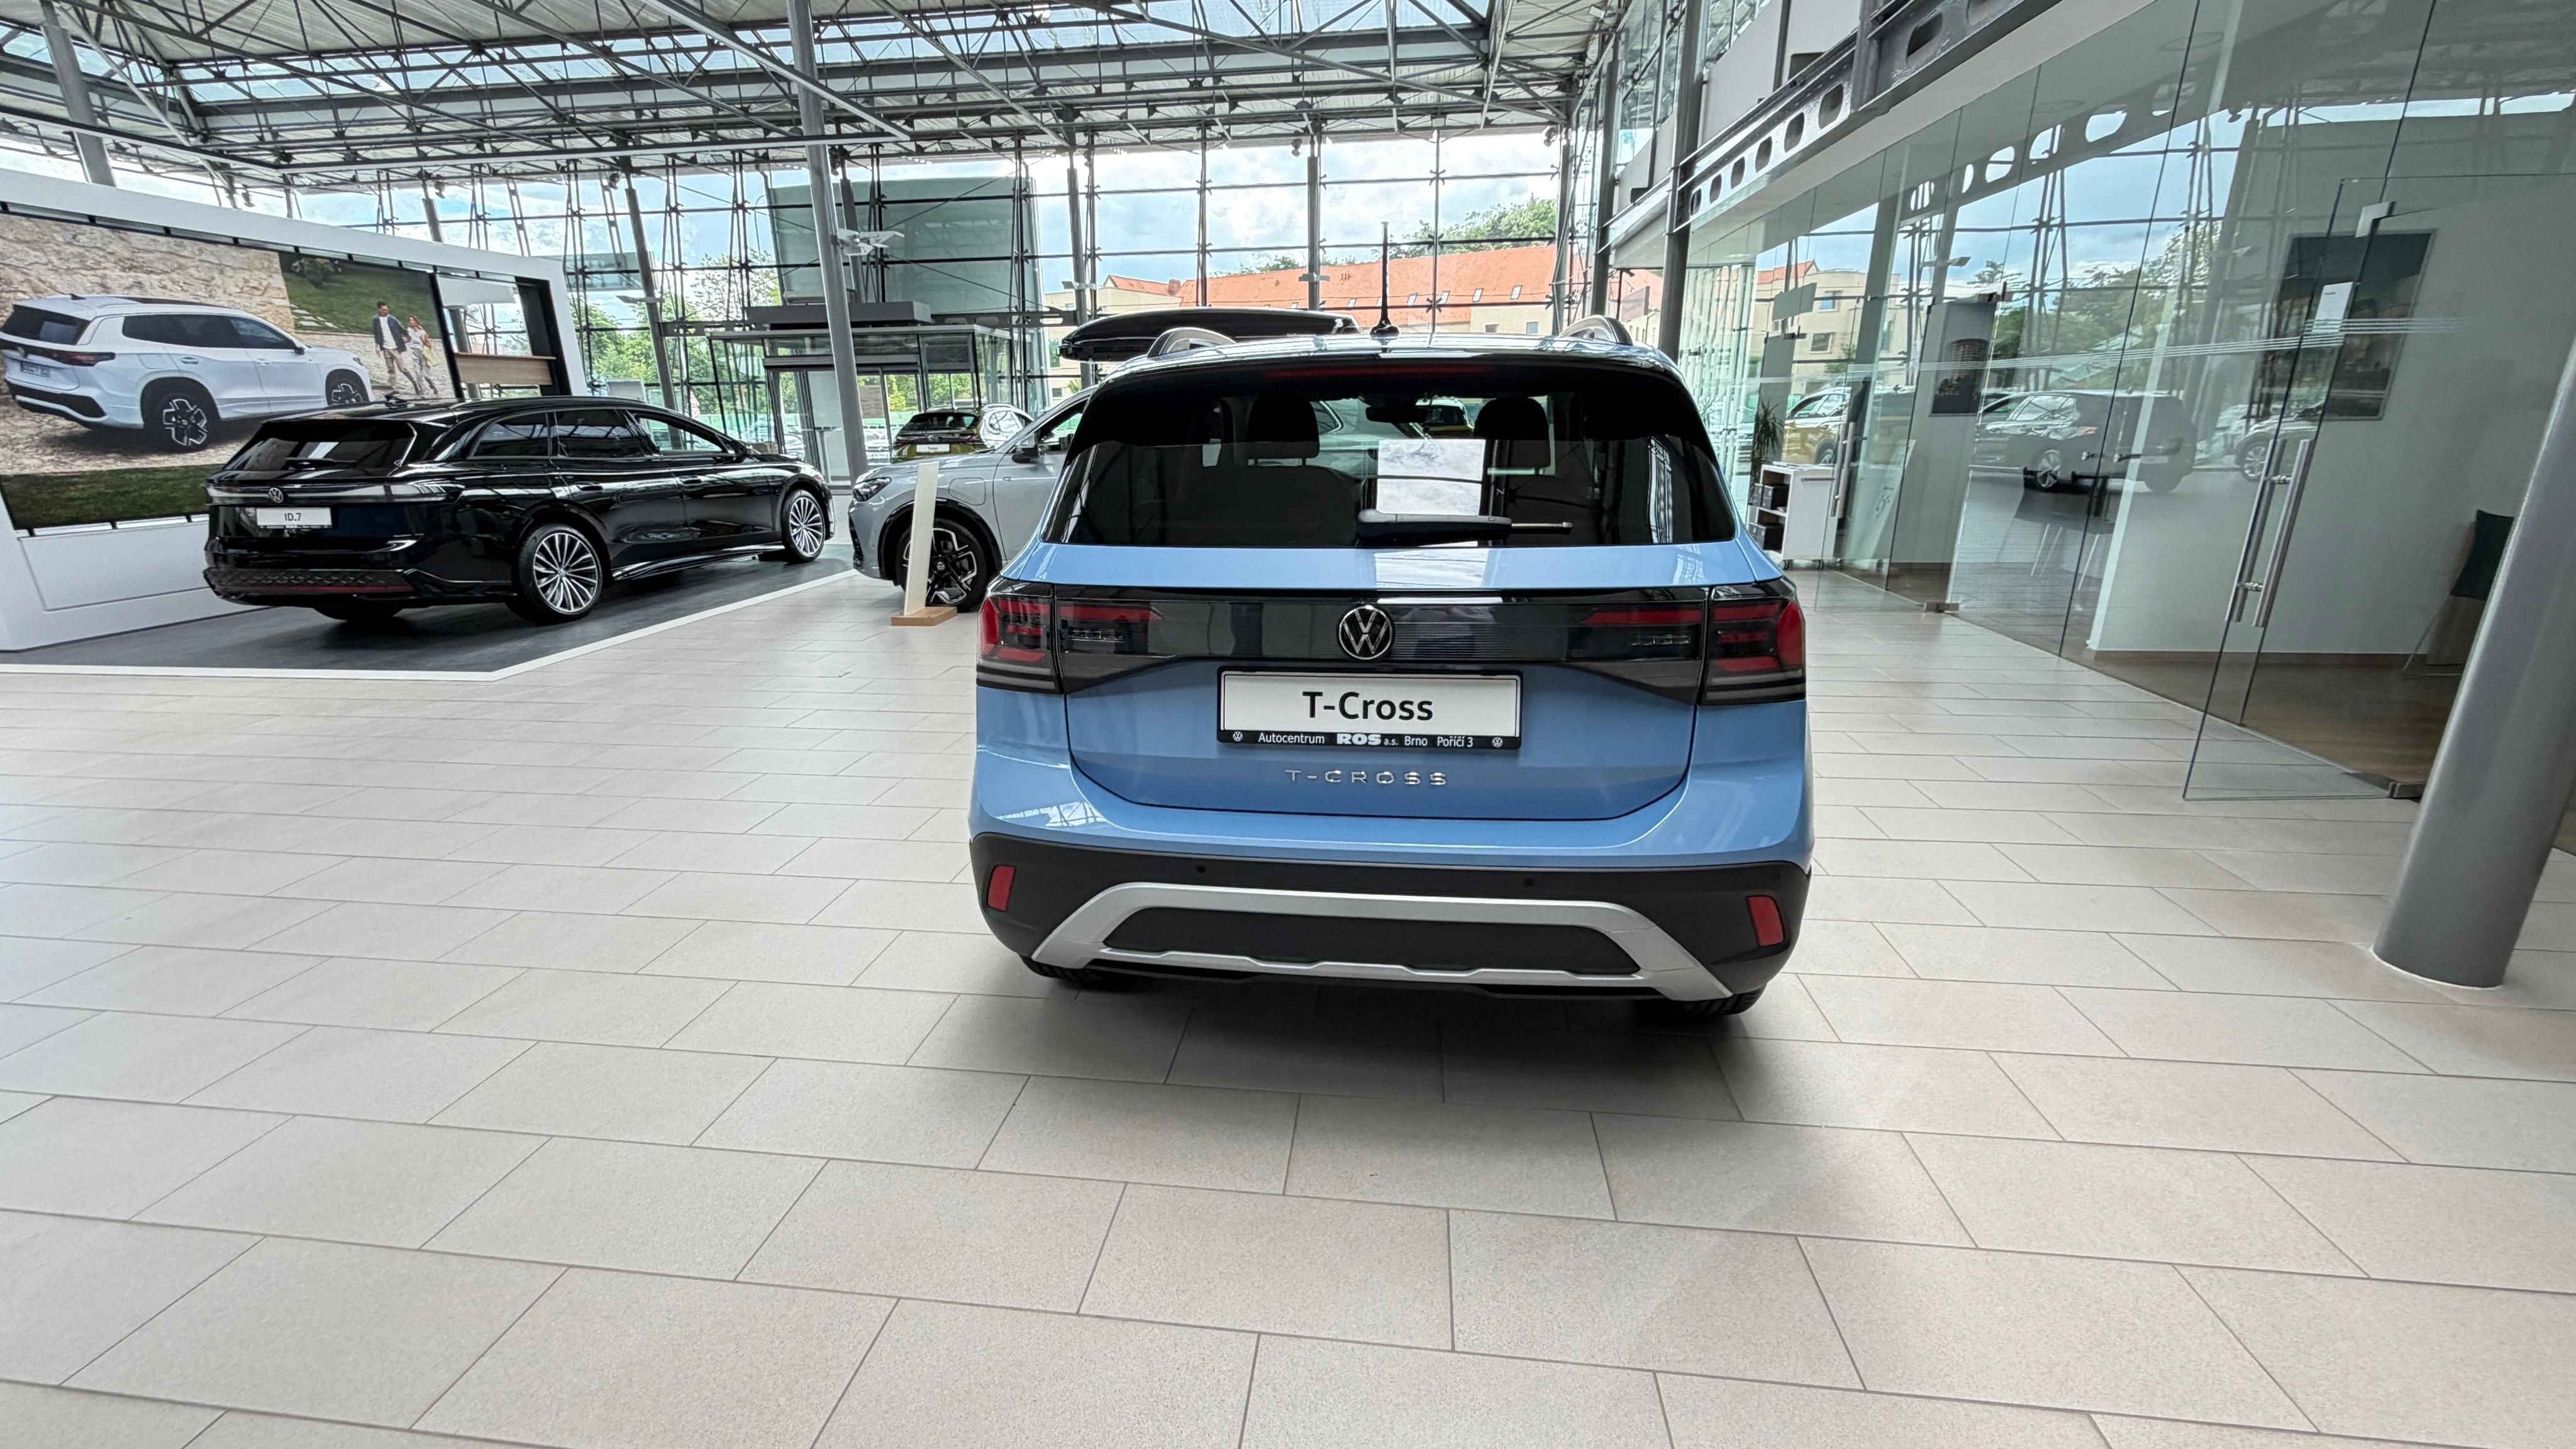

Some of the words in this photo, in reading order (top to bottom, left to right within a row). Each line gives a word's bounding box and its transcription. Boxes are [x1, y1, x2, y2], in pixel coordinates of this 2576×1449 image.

[284, 513, 302, 521] ID.7
[1302, 691, 1433, 721] T-Cross
[1258, 732, 1324, 744] Autocentrum
[1336, 733, 1381, 745] ROS
[1404, 736, 1428, 747] Brno
[1436, 736, 1464, 747] Poříčí
[1467, 738, 1473, 747] 3
[1284, 769, 1447, 786] T-CROSS
